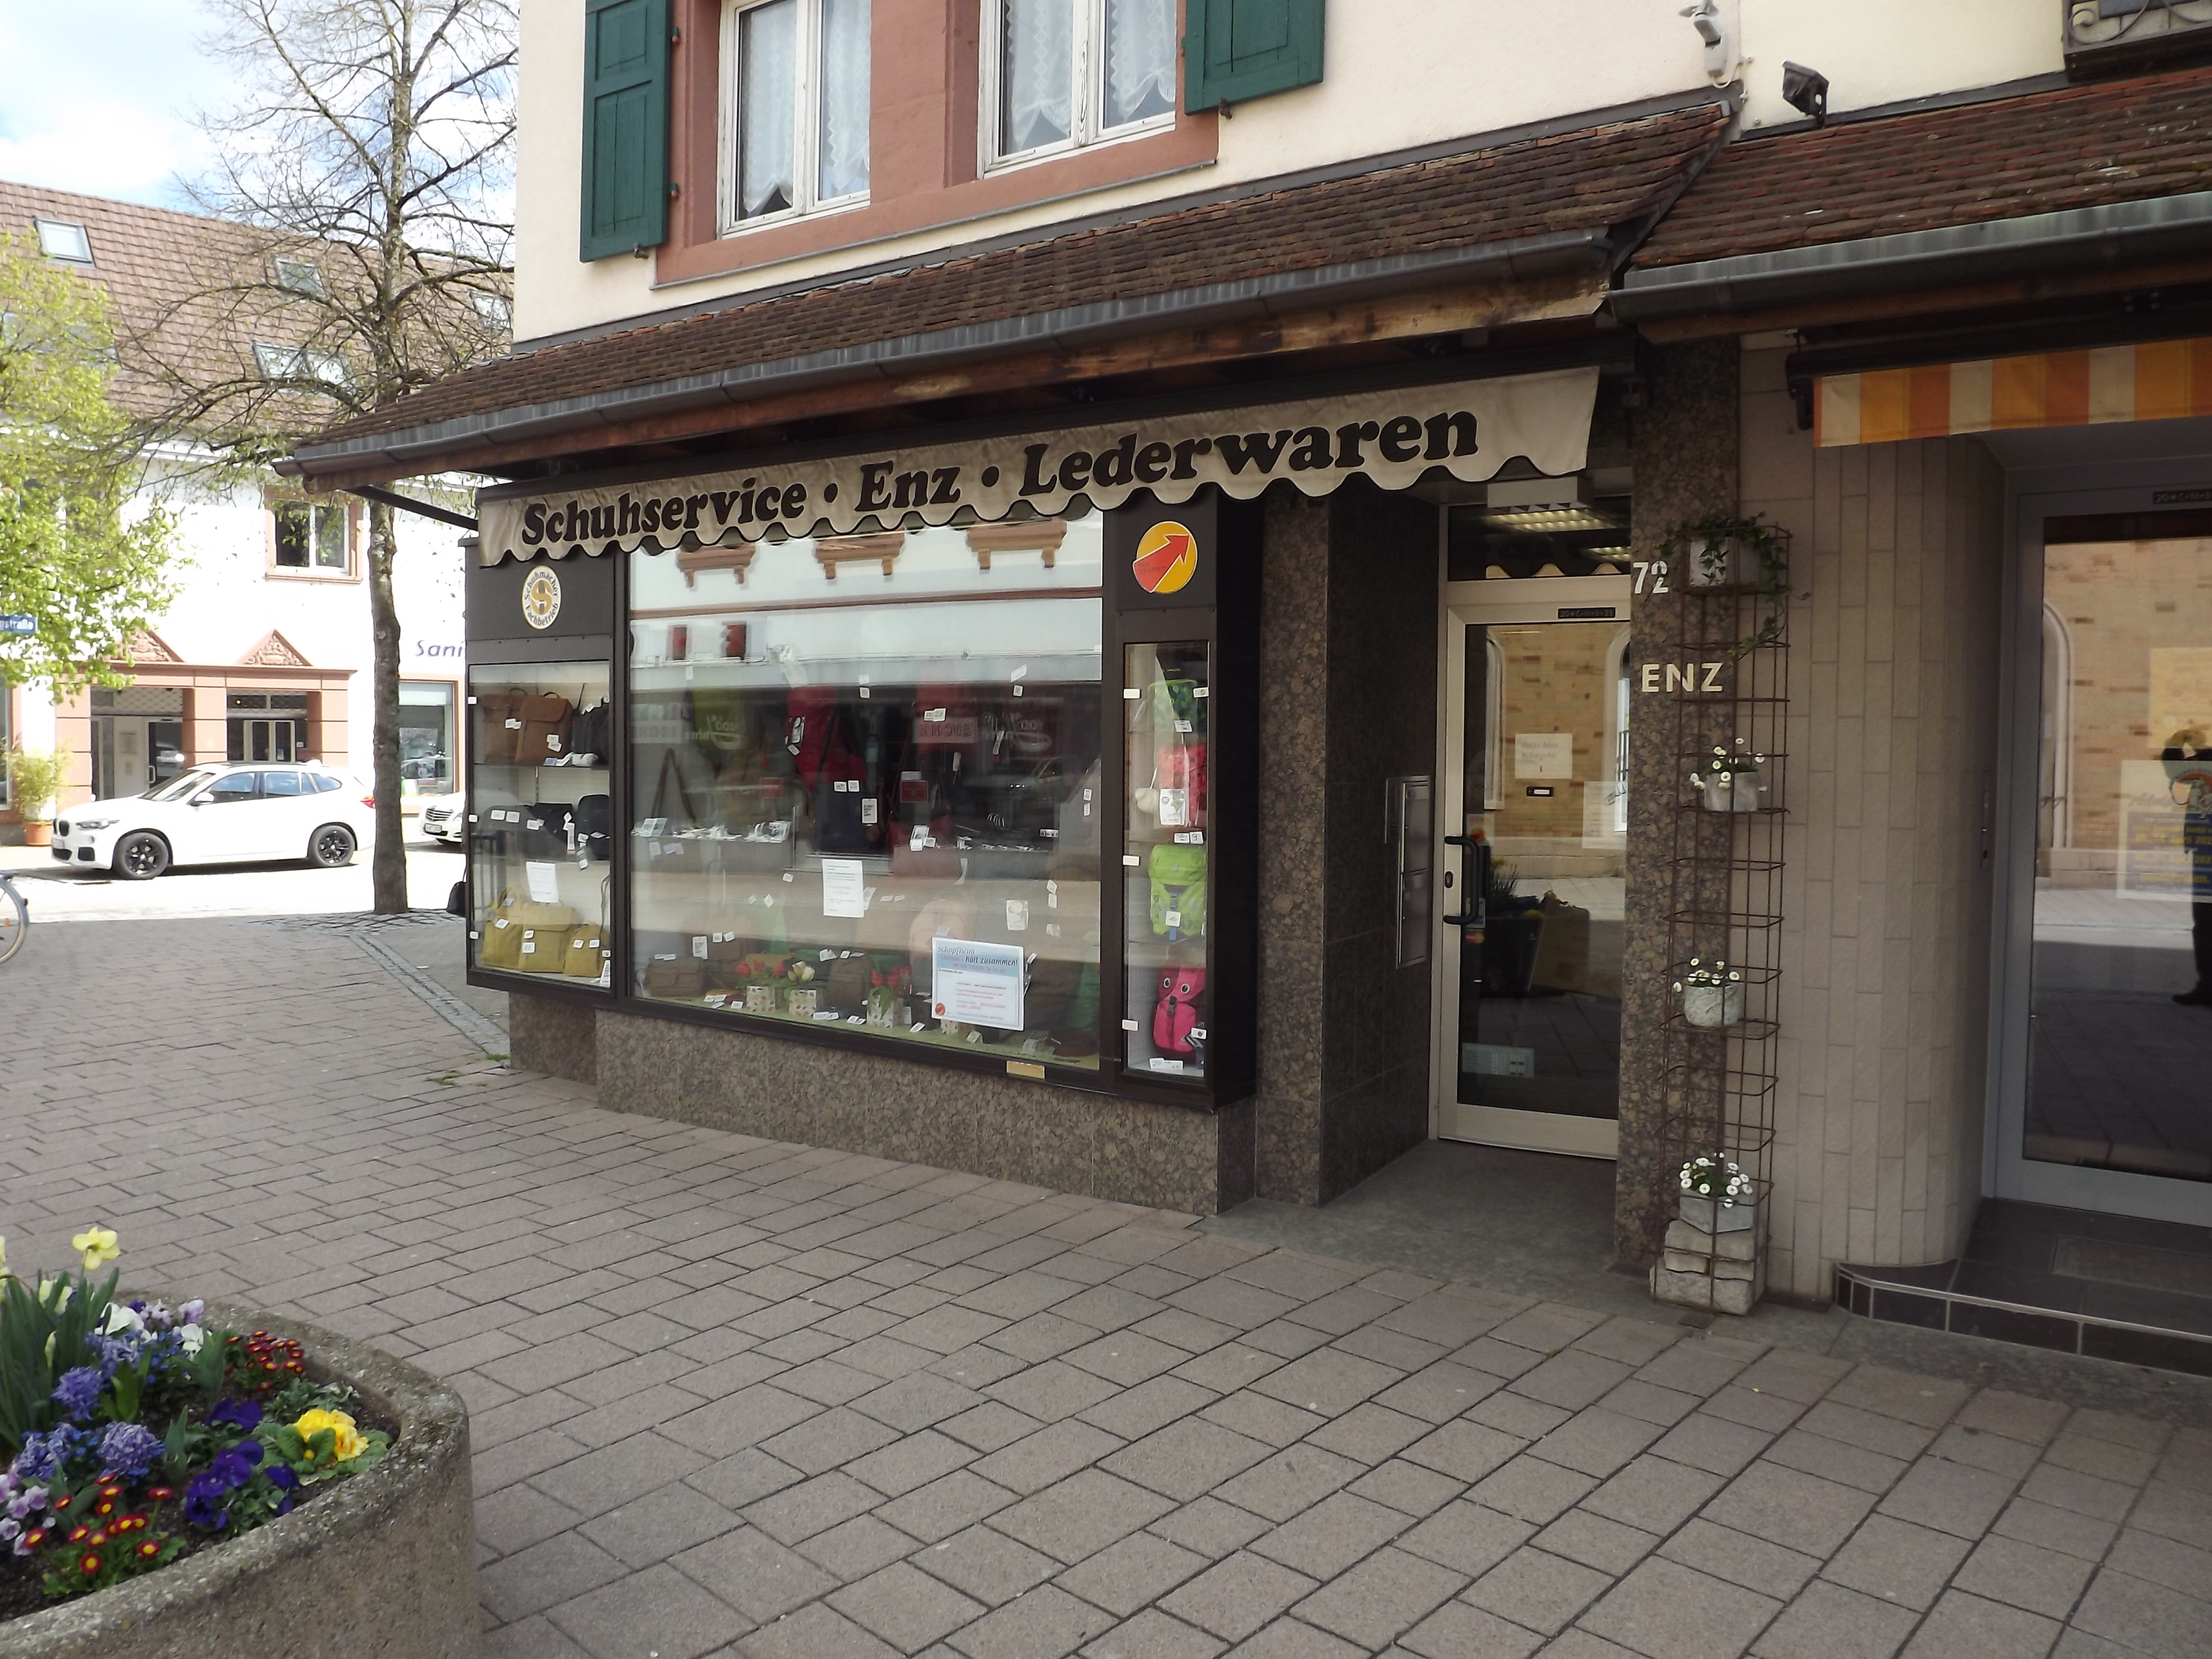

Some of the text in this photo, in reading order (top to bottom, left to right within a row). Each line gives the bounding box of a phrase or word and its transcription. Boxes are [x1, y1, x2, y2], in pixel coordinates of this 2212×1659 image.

[521, 409, 1480, 546] Schuhservice Enz Lederwaren
[524, 571, 558, 601] Schuhmacher
[1632, 560, 1669, 594] 72
[525, 603, 559, 626] Fachbetrieb
[1642, 662, 1724, 693] ENZ
[938, 945, 975, 956] Schopfheim
[965, 955, 979, 964] hält
[980, 957, 1019, 967] zusammen!
